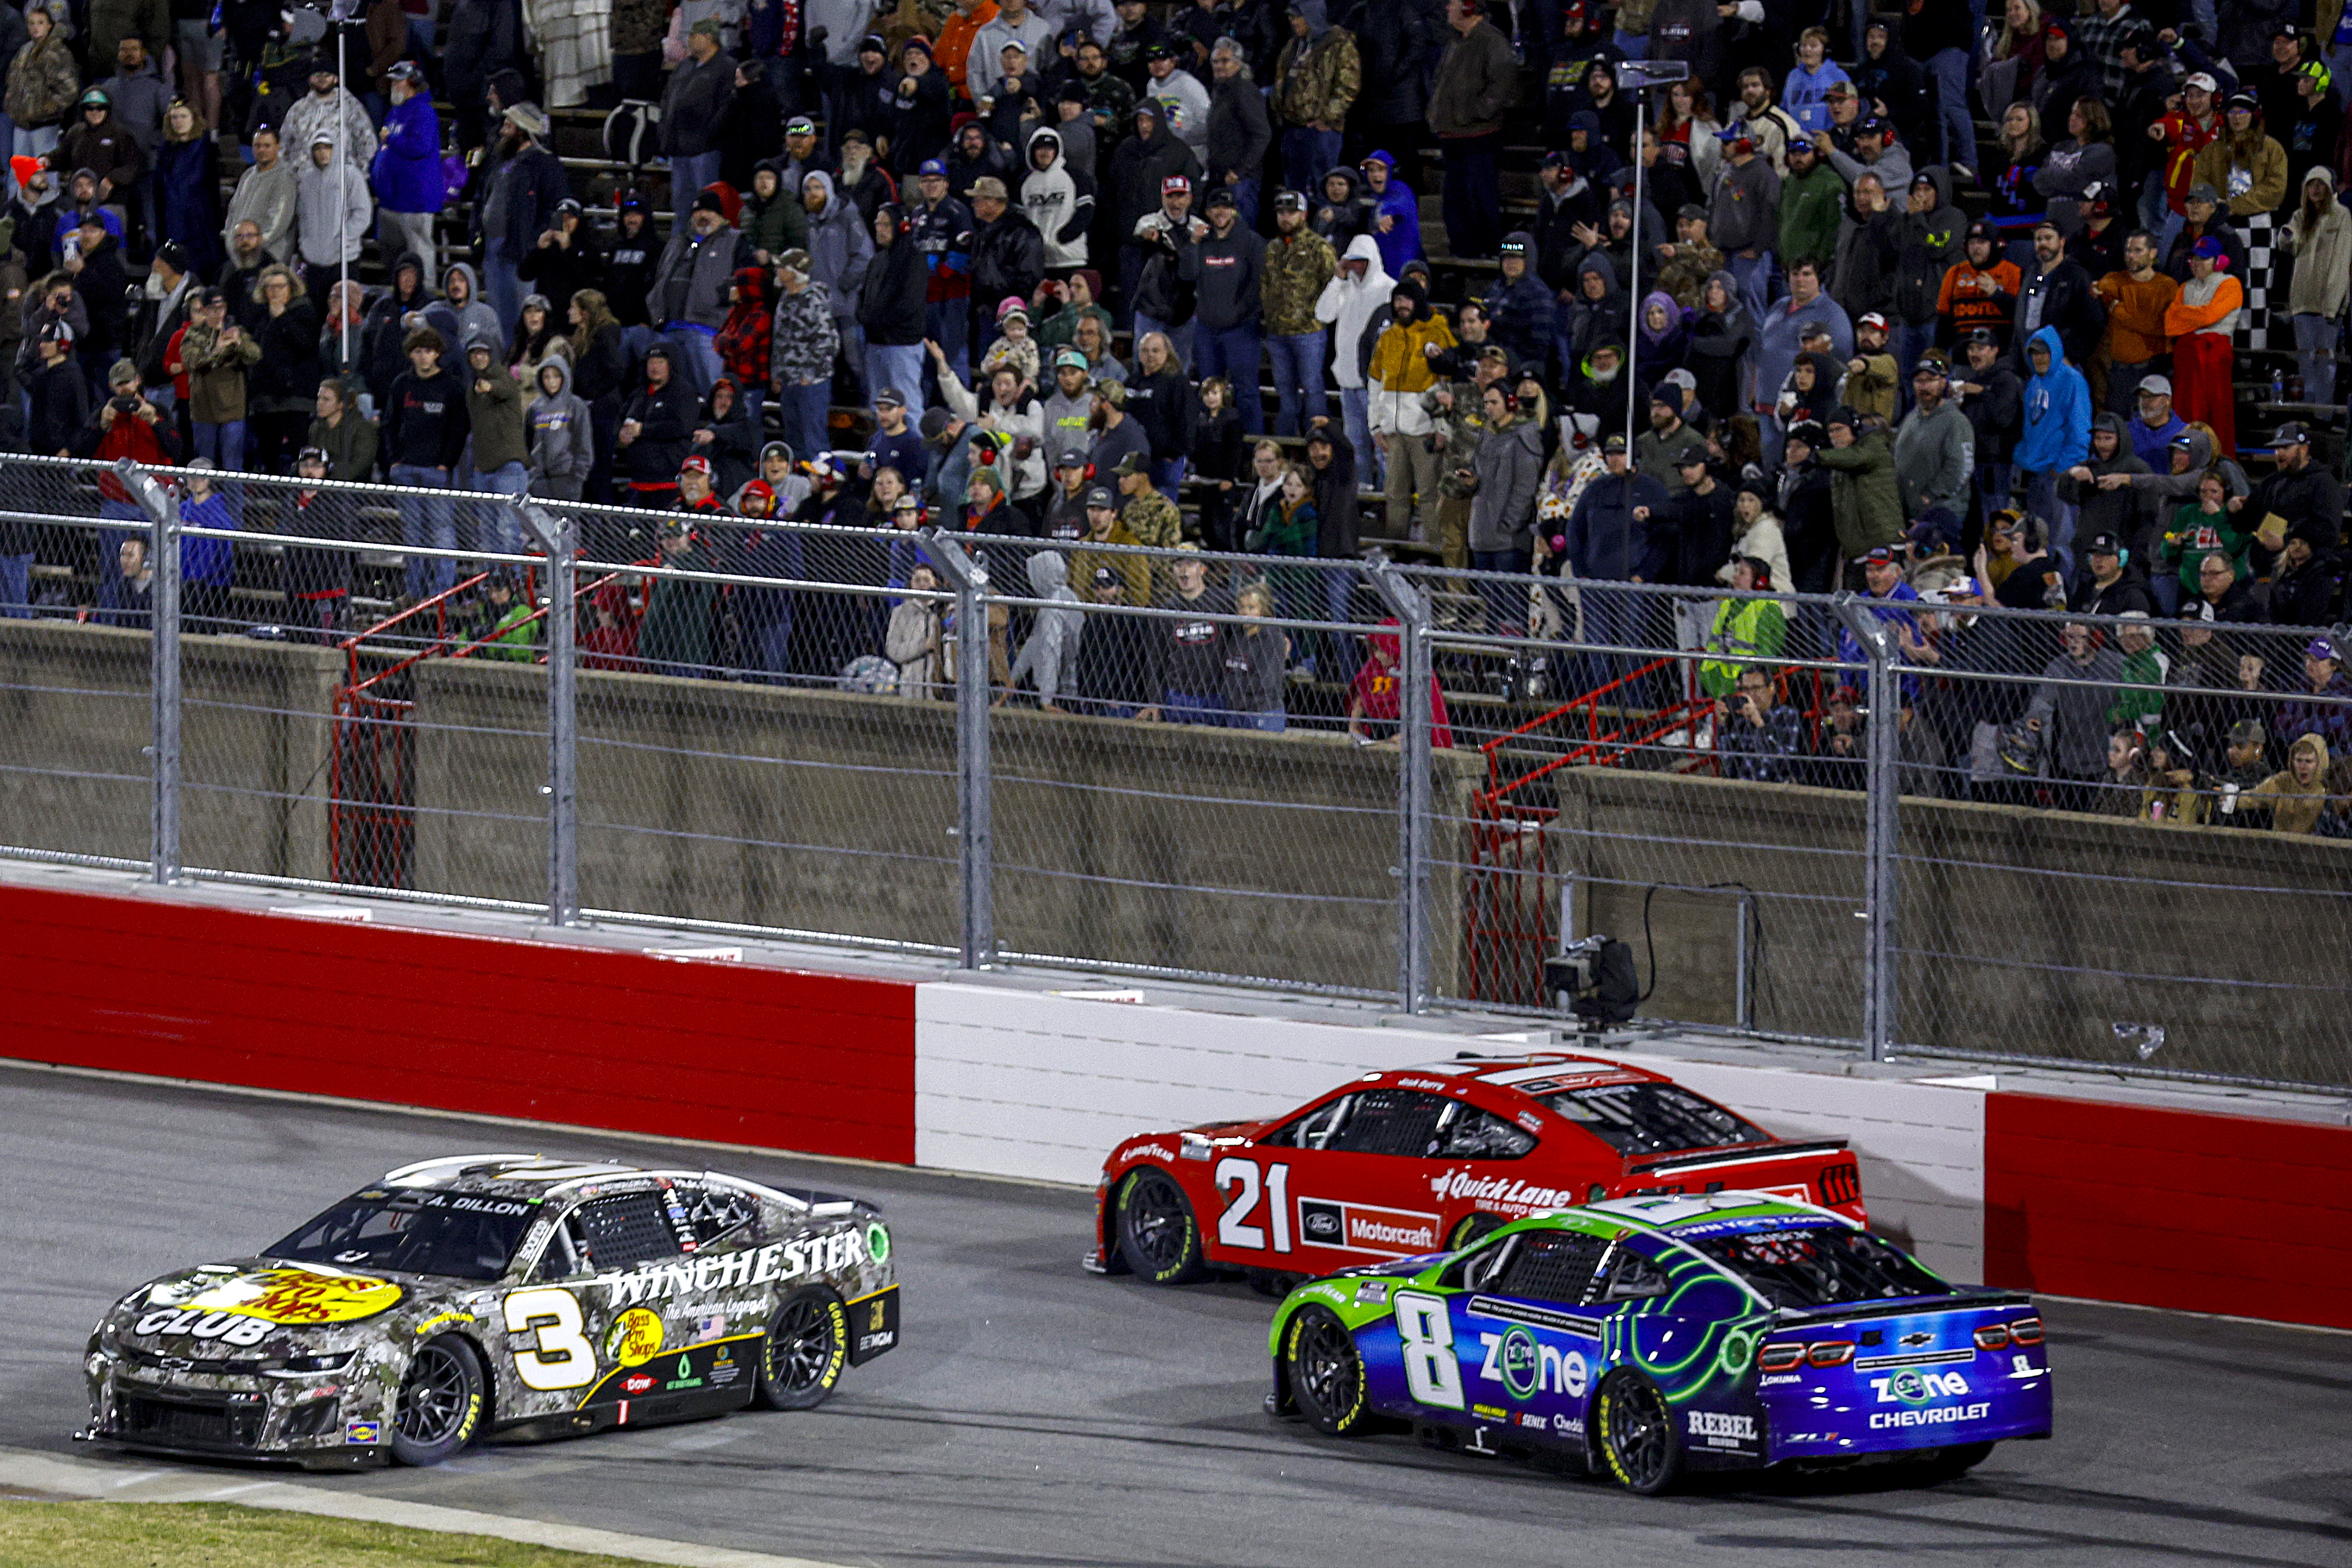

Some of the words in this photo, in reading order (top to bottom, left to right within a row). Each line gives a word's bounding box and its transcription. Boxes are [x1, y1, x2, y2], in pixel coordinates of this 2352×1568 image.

[1215, 1157, 1292, 1253] 21
[1450, 1171, 1512, 1200] Quick
[1505, 1179, 1572, 1208] Lane
[426, 1195, 447, 1207] A.
[452, 1197, 529, 1216] DILLON
[1351, 1217, 1434, 1248] Motorcraft
[603, 1226, 869, 1309] WINCHESTER
[626, 1312, 651, 1328] Bass
[664, 1304, 682, 1320] The
[683, 1298, 725, 1318] American
[134, 1308, 277, 1346] CLUB
[503, 1287, 597, 1391] 3
[627, 1327, 645, 1343] Pro
[628, 1341, 656, 1358] Shops
[821, 1301, 846, 1389] GOODYEAR
[1393, 1288, 1466, 1411] 8
[626, 1377, 652, 1392] DOW
[1688, 1410, 1758, 1441] REBEL
[1869, 1402, 1991, 1429] CHEVROLET
